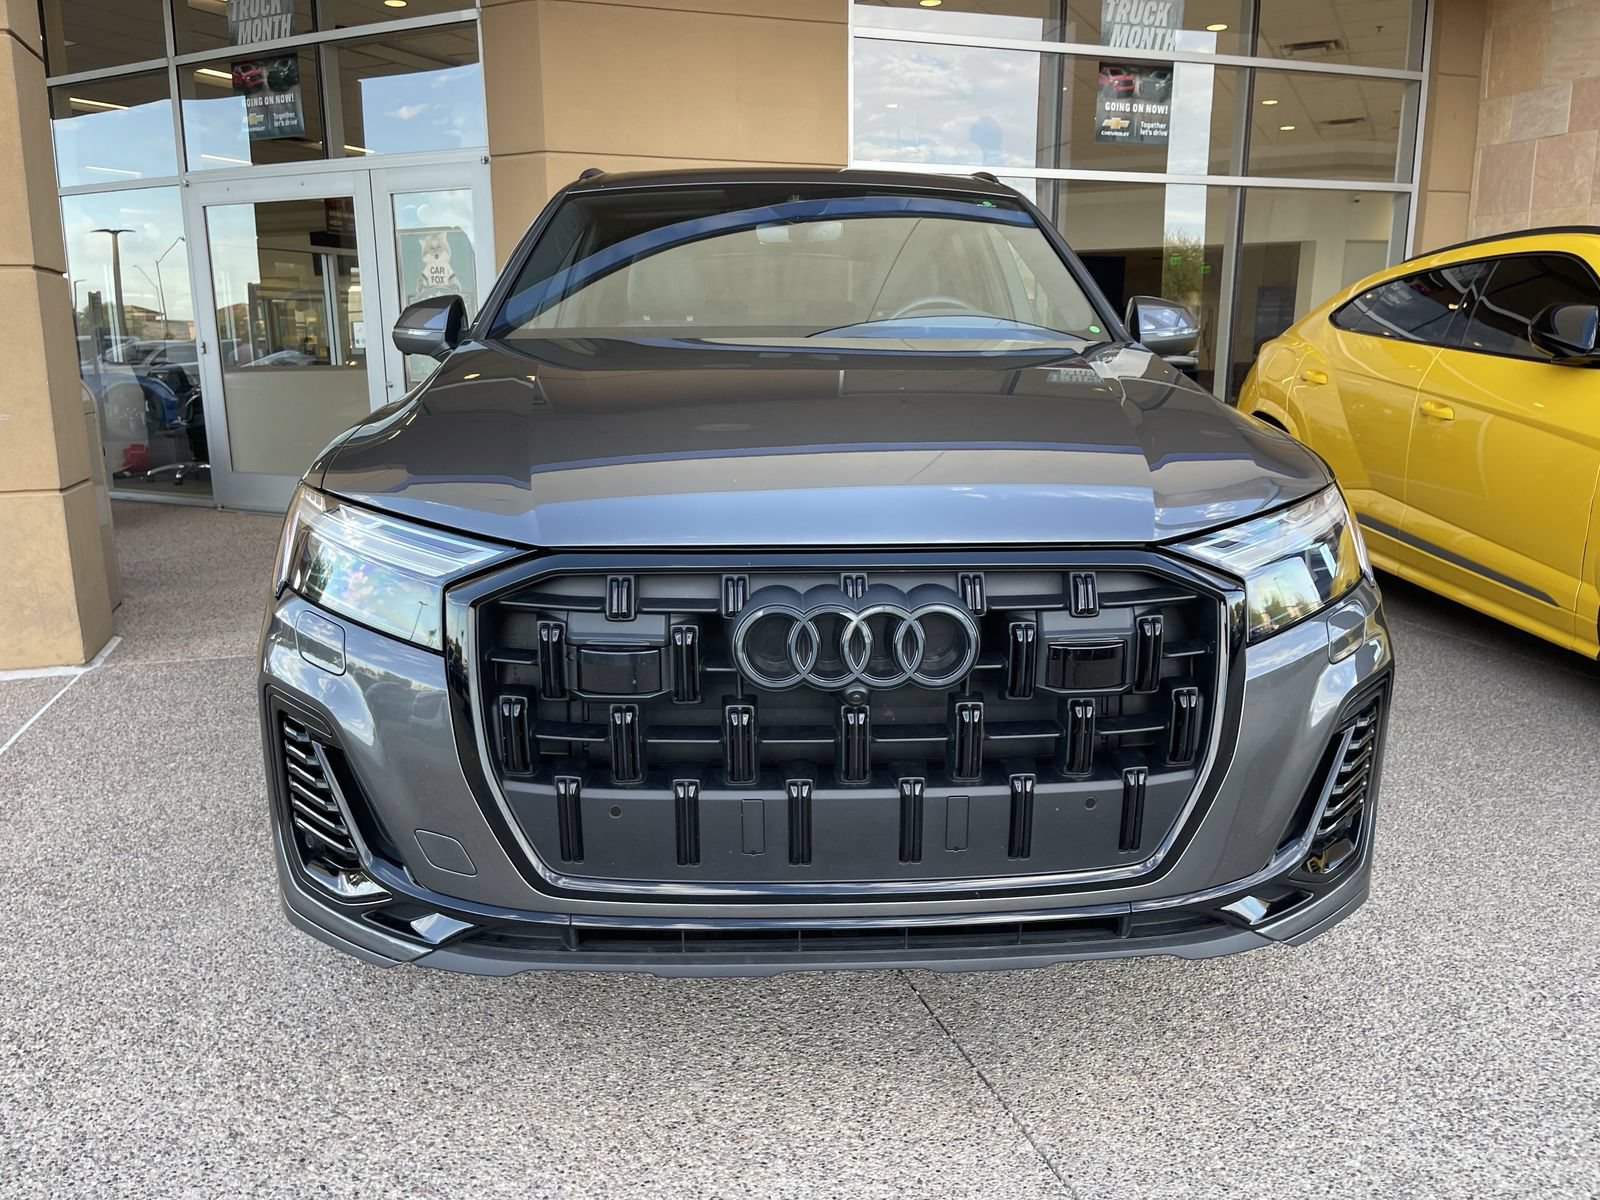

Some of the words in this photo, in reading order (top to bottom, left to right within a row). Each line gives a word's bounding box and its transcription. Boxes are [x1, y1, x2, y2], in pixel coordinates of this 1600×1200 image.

[231, 0, 281, 21] TRUCK
[1106, 0, 1172, 27] TRUCK
[238, 13, 292, 45] MONTH
[1109, 24, 1177, 52] MONTH
[242, 97, 263, 108] GOING
[264, 95, 274, 106] ON
[275, 92, 294, 104] NOW!
[1105, 101, 1131, 112] GOING
[1132, 103, 1144, 113] ON
[1145, 104, 1169, 115] NOW!
[273, 111, 295, 120] Together
[285, 119, 298, 127] drive
[1140, 120, 1167, 129] Together
[1139, 128, 1153, 136] let's
[1153, 128, 1168, 137] drive
[430, 266, 445, 274] CAR
[431, 275, 445, 284] FOX
